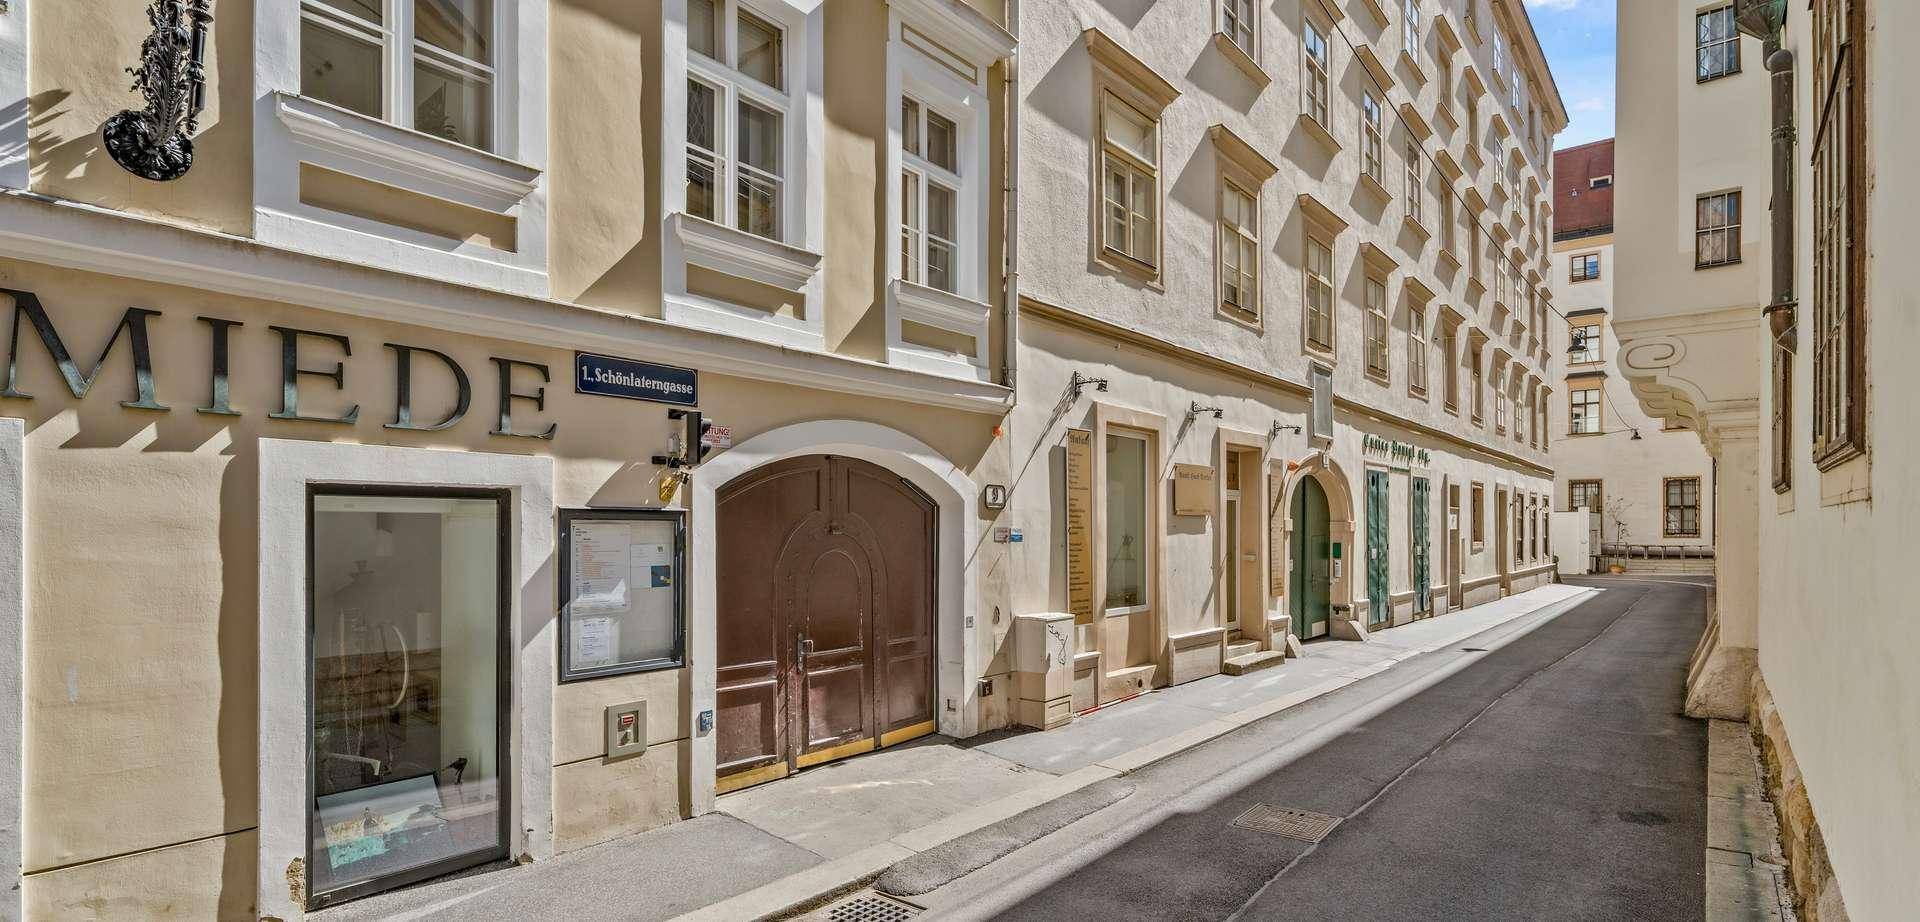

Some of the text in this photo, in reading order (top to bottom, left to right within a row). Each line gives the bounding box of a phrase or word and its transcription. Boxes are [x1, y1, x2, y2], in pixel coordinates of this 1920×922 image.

[0, 287, 558, 441] MIEDE
[594, 367, 693, 394] Schönlaterngasse
[992, 487, 999, 503] 9
